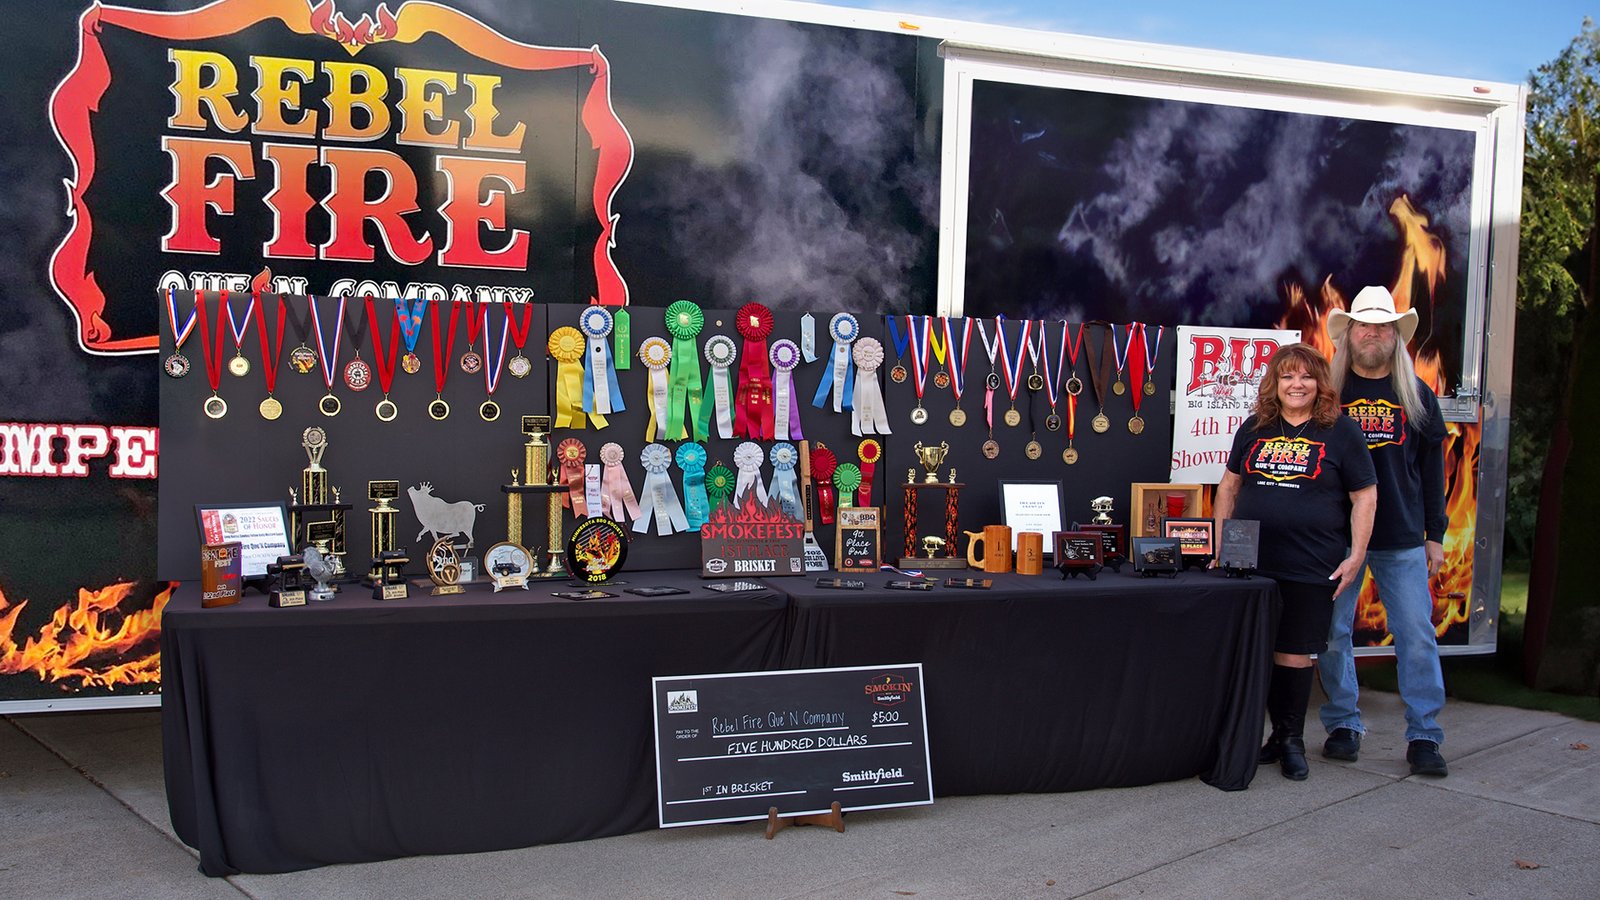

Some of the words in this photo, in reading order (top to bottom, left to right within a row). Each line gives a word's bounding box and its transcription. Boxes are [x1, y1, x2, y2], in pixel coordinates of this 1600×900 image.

[167, 47, 527, 154] REBEL
[158, 135, 532, 272] FIRE
[1188, 400, 1203, 408] BIG
[1207, 400, 1241, 409] ISLAND
[1348, 406, 1395, 418] REBEL
[1190, 416, 1220, 437] 4th
[1263, 441, 1311, 452] REBEL
[1256, 449, 1310, 466] FIRE
[1277, 464, 1308, 473] COMPANY
[701, 523, 804, 540] SMOKEFEST
[721, 544, 743, 558] 1ST
[747, 544, 789, 558] PLACE
[734, 559, 776, 572] BRISKET
[587, 573, 607, 582] 2018
[712, 716, 739, 734] Rebel
[743, 714, 763, 730] Fire
[803, 710, 845, 728] Company
[871, 710, 899, 723] $500
[728, 741, 758, 755] FIVE
[761, 738, 814, 753] HUNDRED
[818, 734, 868, 749] DOLLARS
[842, 767, 904, 784] Smithfield
[715, 784, 728, 795] IN
[731, 781, 774, 793] BRISKET
